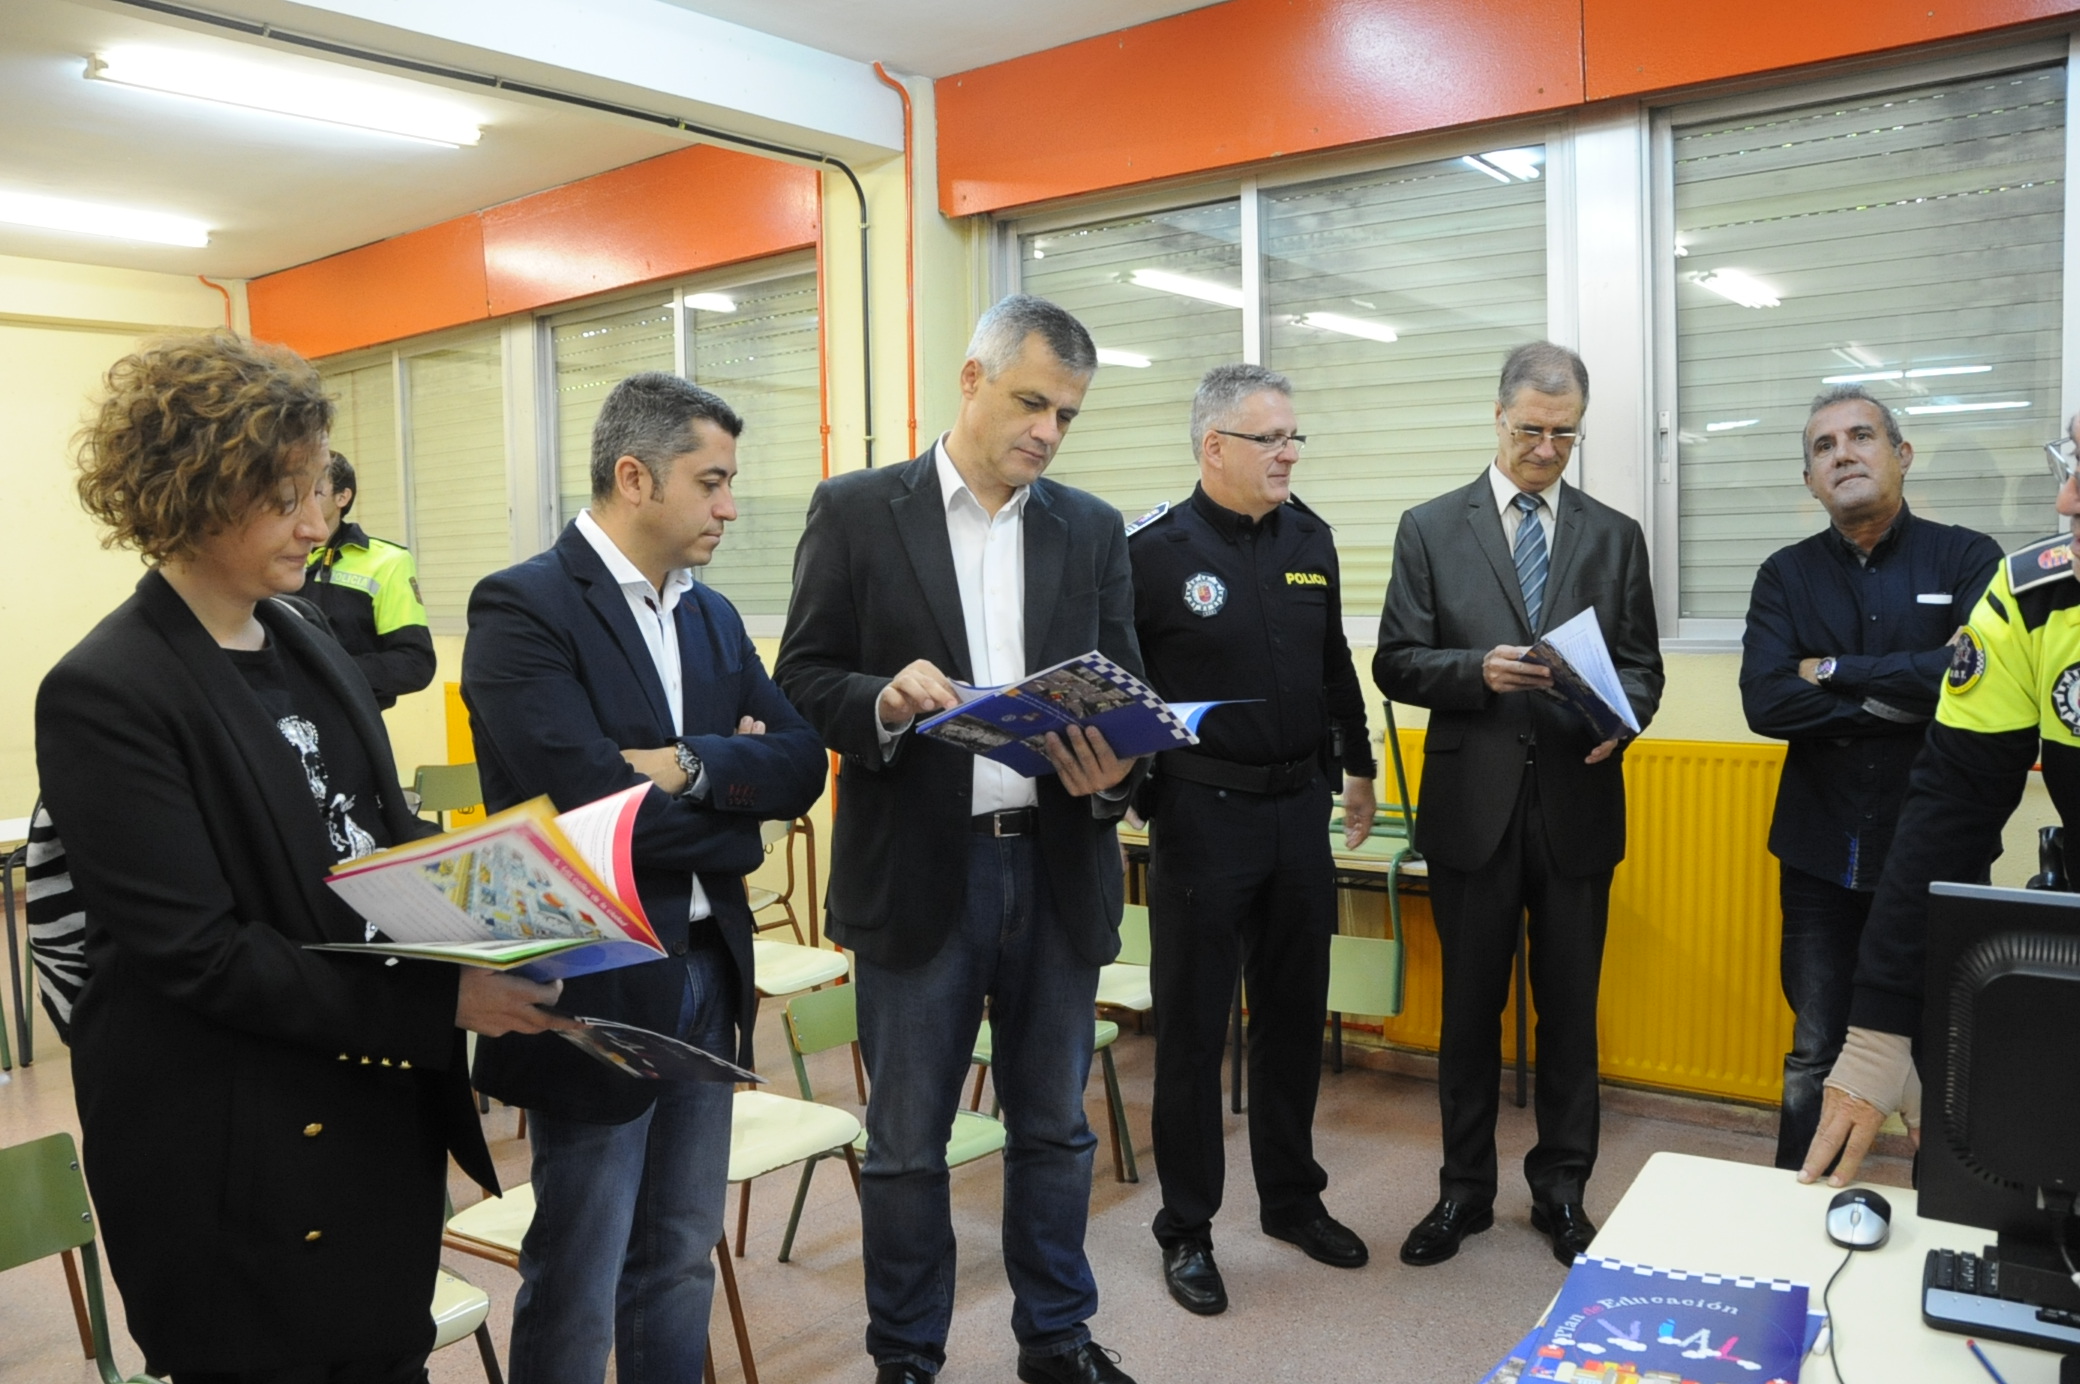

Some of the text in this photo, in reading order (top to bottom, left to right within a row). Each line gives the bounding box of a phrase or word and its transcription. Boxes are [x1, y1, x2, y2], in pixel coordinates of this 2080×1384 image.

[1554, 1295, 1740, 1341] Plan de Educación
